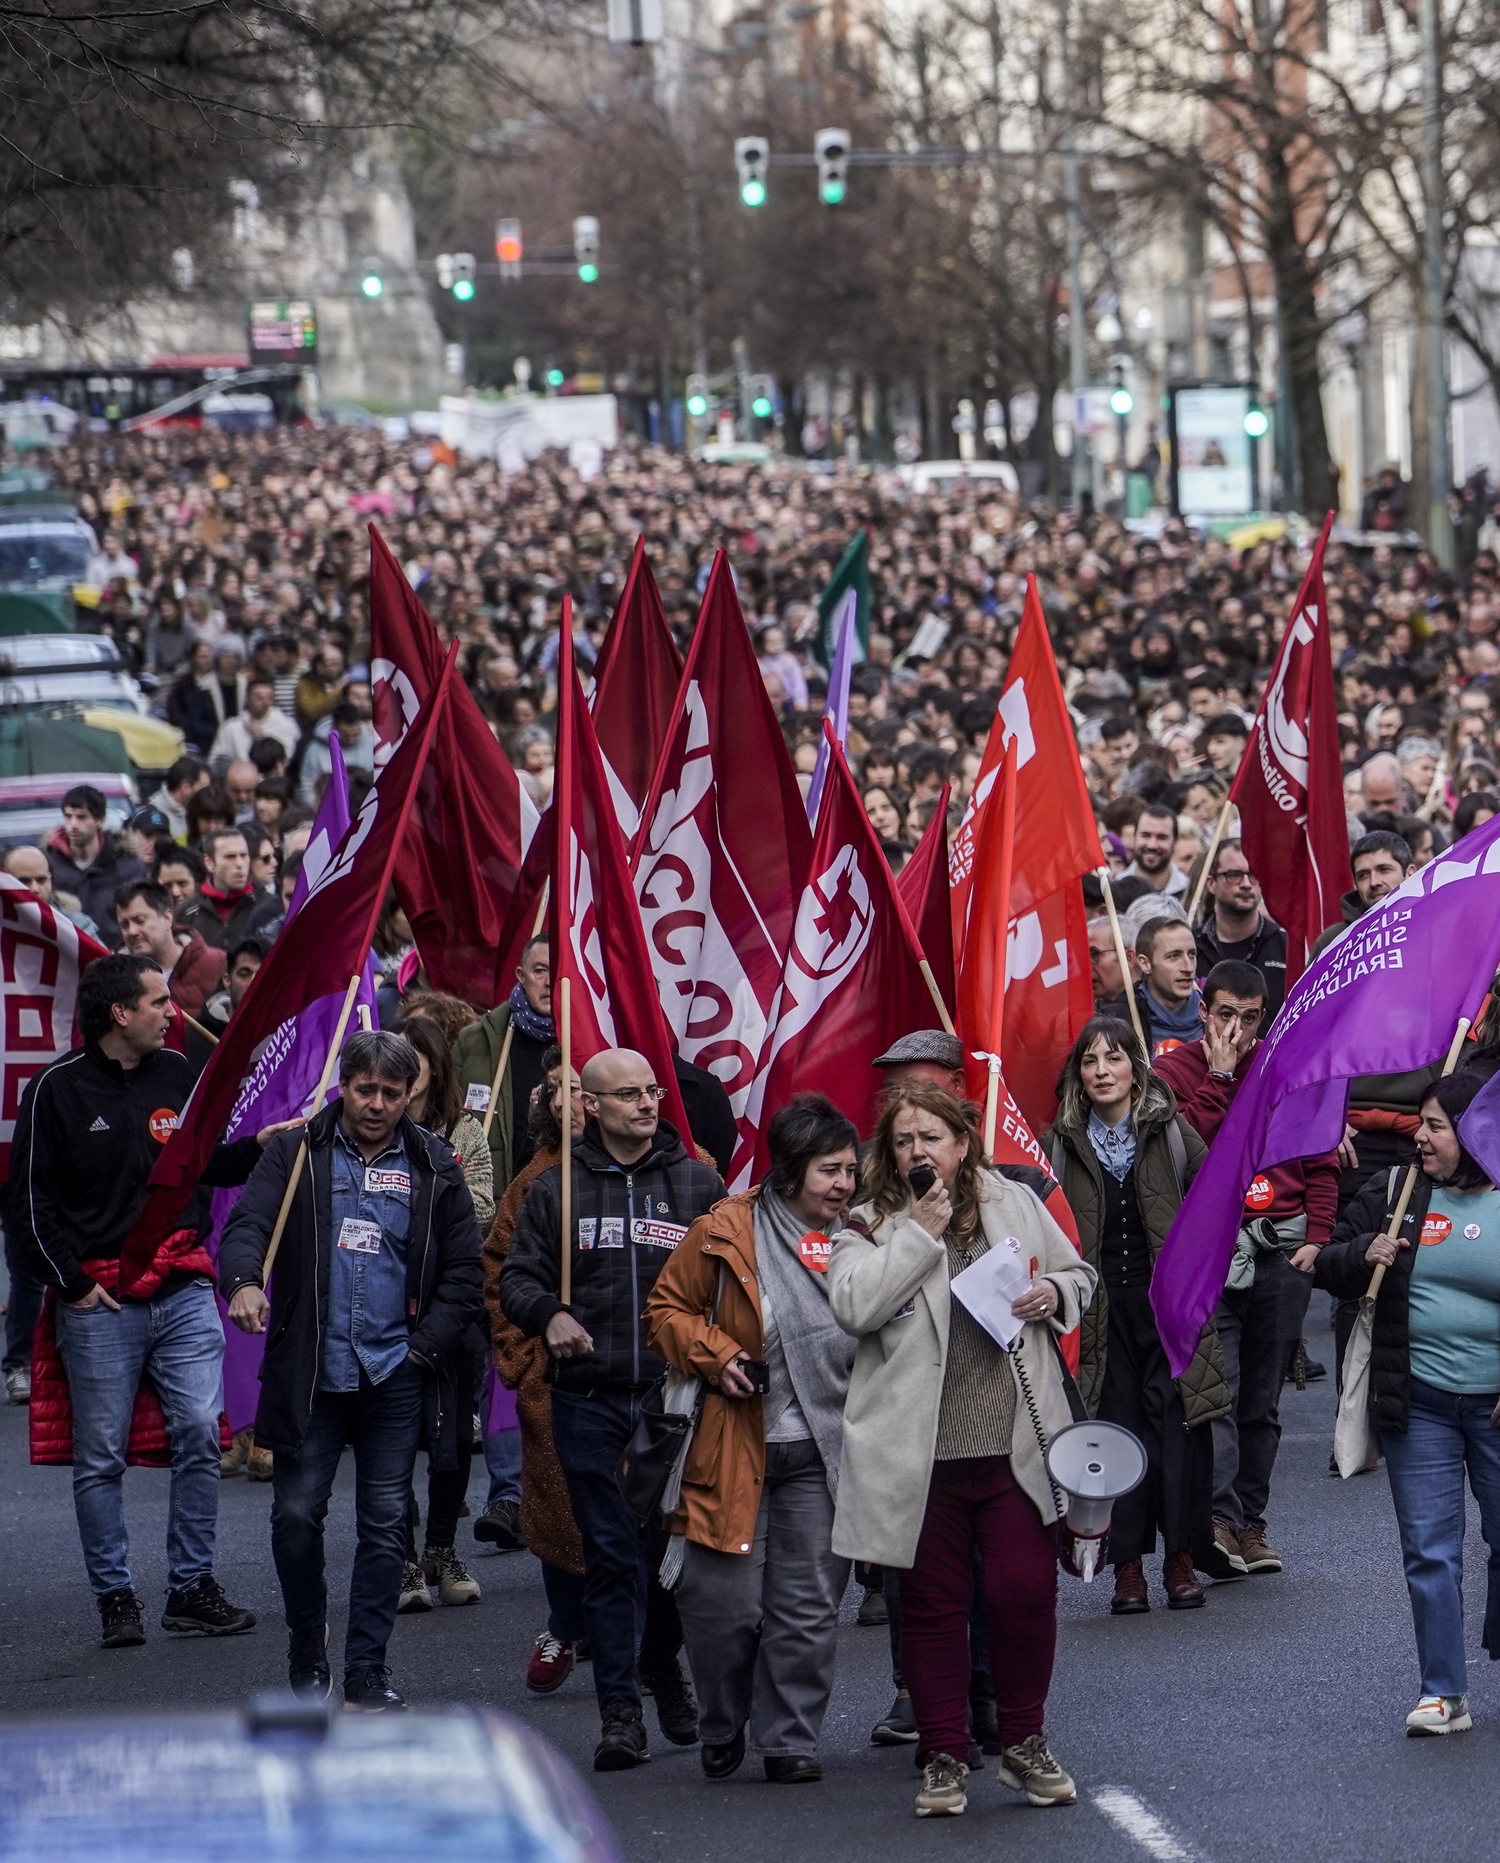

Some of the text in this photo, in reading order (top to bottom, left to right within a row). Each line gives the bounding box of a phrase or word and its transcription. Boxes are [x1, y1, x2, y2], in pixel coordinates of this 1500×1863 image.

[368, 1184, 411, 1194] irakaskunt
[632, 1236, 678, 1249] irakaskunt
[801, 1242, 832, 1255] LAB
